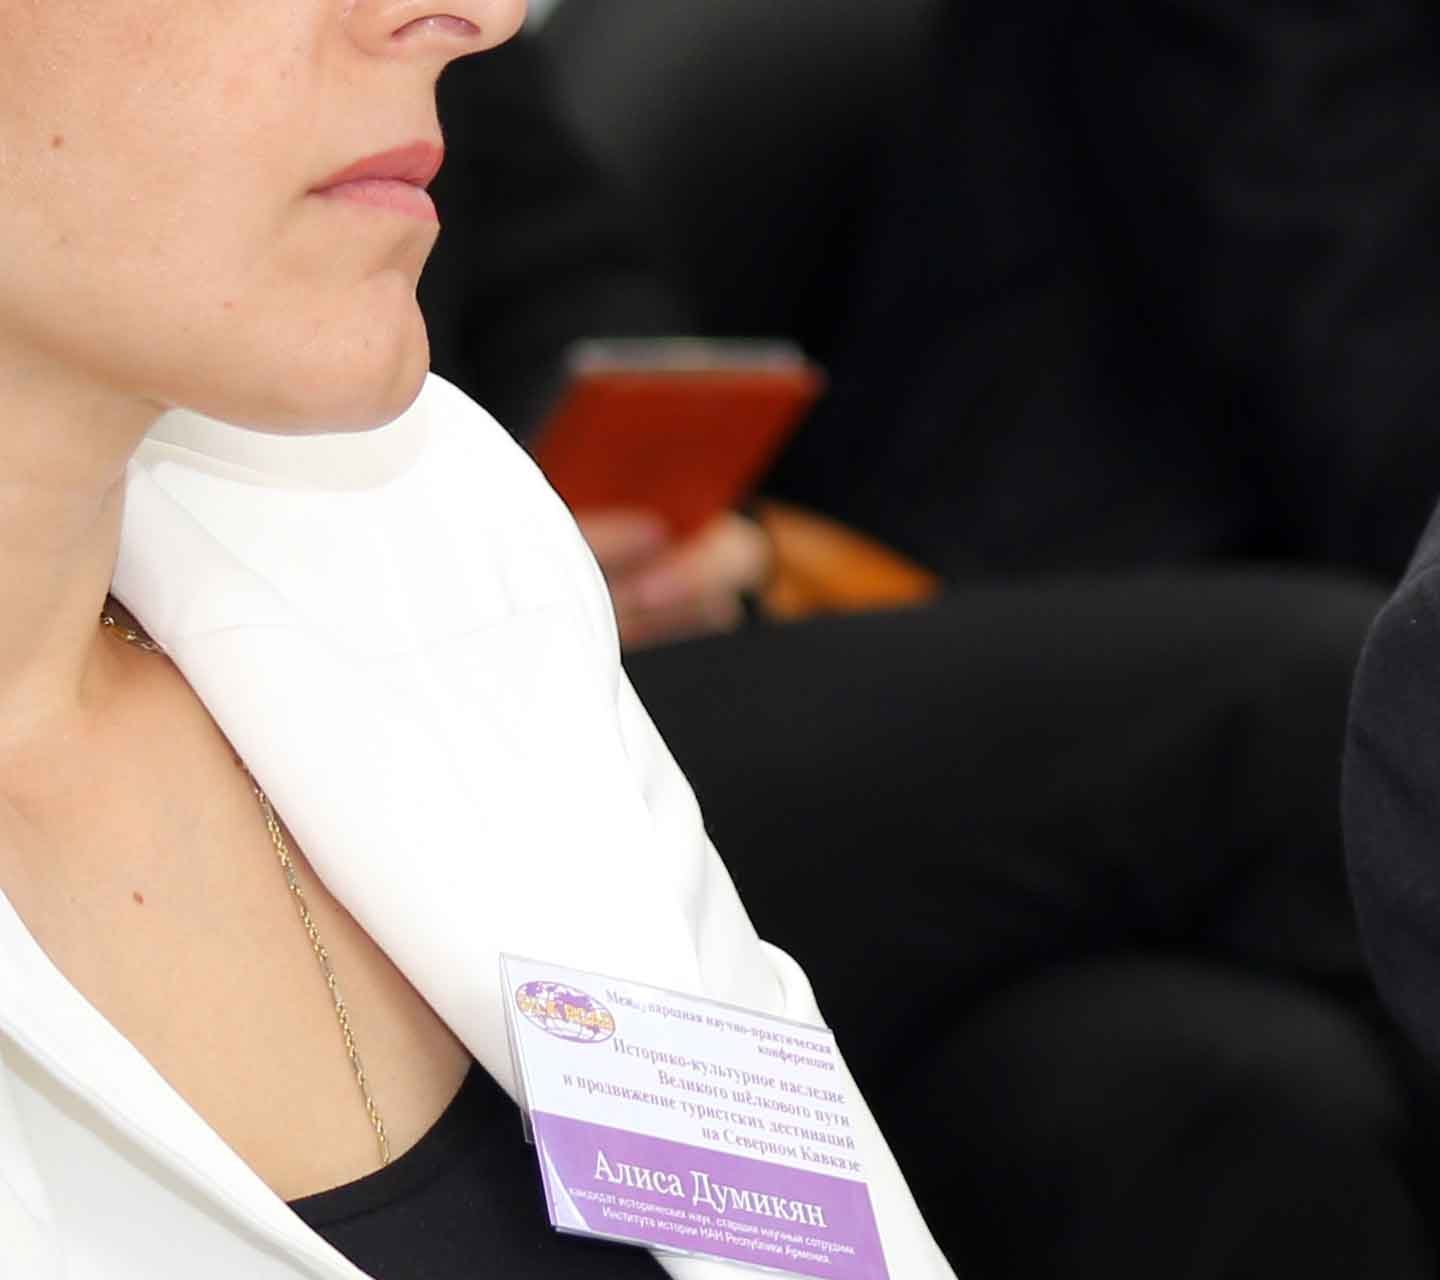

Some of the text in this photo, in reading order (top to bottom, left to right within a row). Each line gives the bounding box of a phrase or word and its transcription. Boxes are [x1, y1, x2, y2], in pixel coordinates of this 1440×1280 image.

[606, 989, 702, 1024] Межнародная
[613, 1037, 845, 1104] Историко-культурное наследие
[658, 1070, 850, 1128] Великого шёлкового пути
[563, 1074, 855, 1150] и продвижение туристских дестинаций
[702, 1128, 862, 1172] на Северном Кавказе
[593, 1150, 829, 1228] Алиса Думикян
